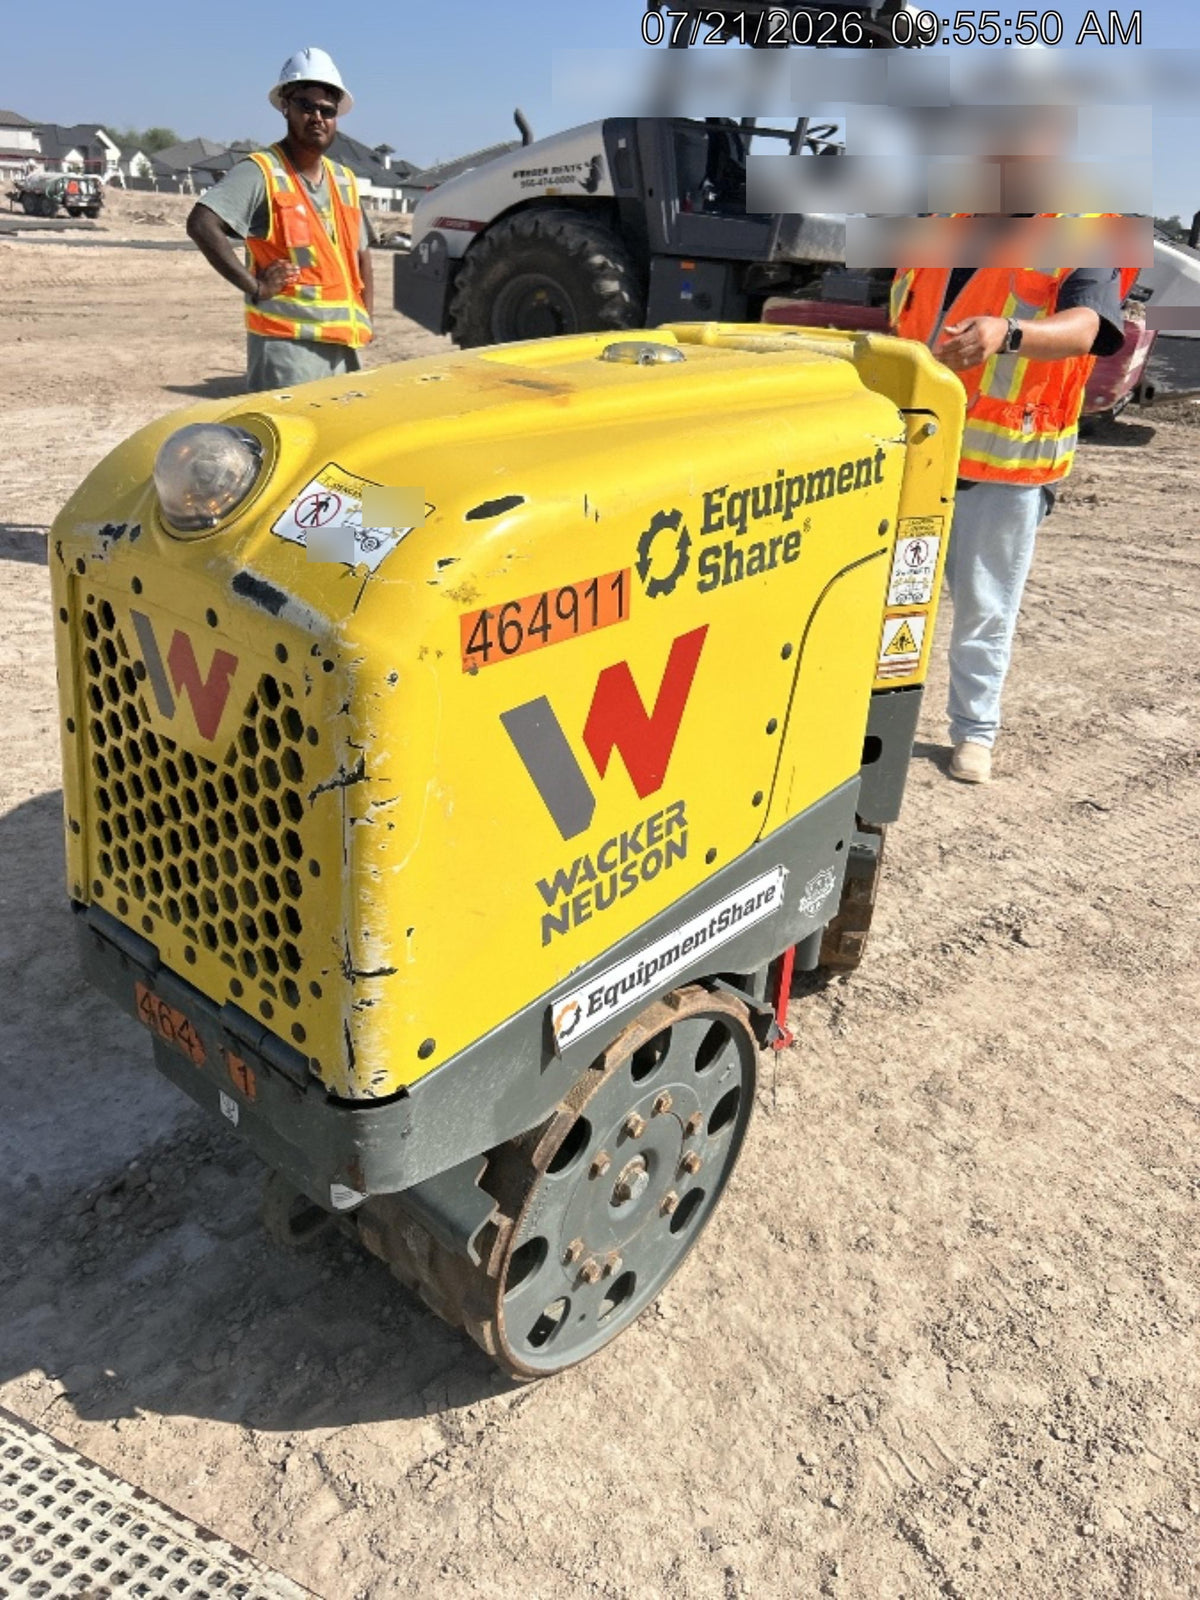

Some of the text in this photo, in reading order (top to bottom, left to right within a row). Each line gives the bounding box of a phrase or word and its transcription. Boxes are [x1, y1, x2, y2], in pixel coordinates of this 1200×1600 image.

[699, 447, 887, 536] Equipment
[697, 529, 802, 594] Share
[465, 569, 626, 662] 464911
[535, 799, 689, 907] WACKER
[541, 830, 688, 949] NEUSON
[585, 884, 776, 1018] EquipmentShare
